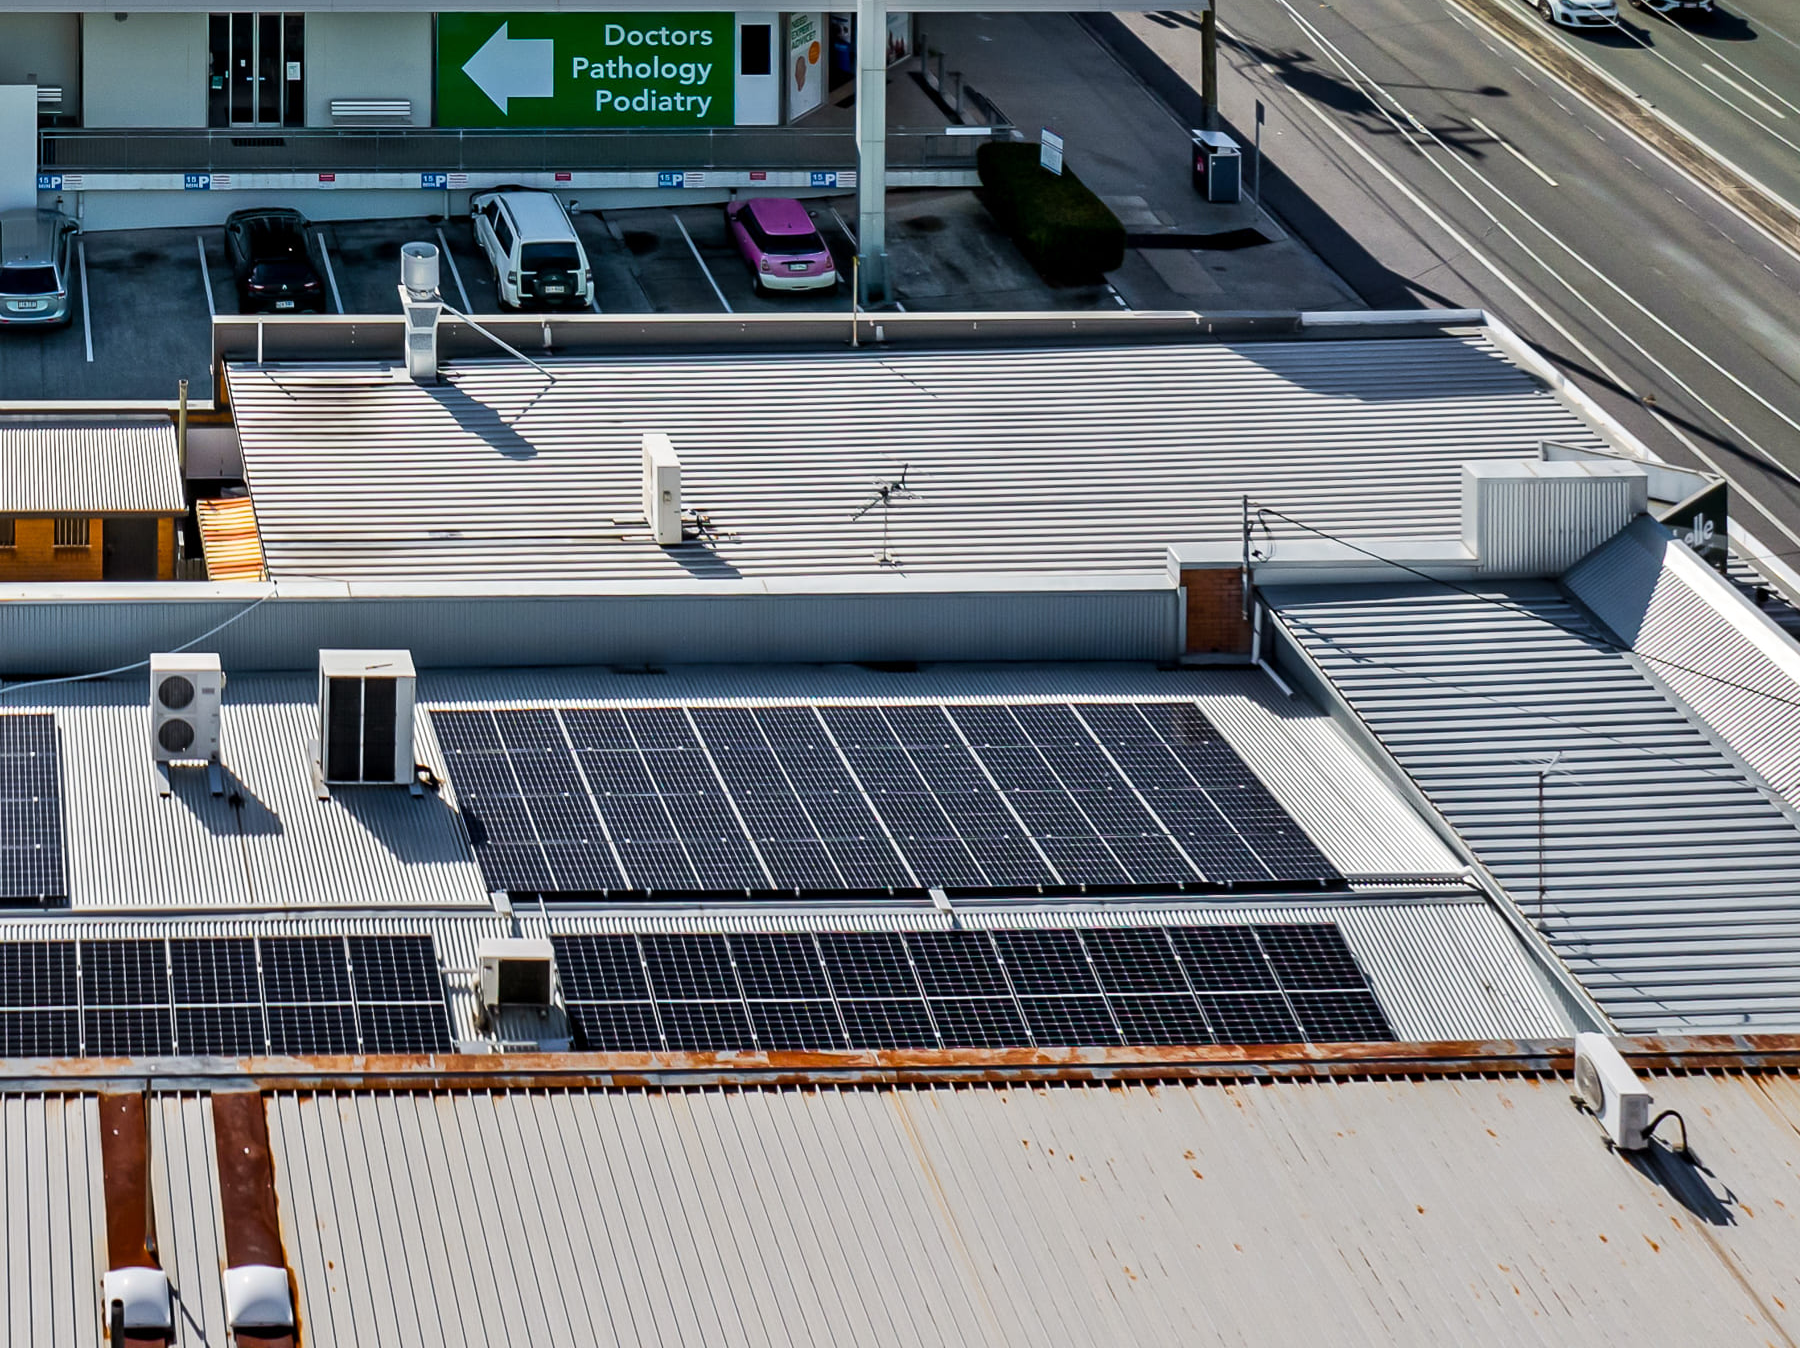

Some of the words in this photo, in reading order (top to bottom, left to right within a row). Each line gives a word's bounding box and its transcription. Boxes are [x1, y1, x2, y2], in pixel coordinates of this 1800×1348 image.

[604, 24, 713, 46] Doctors
[572, 56, 712, 86] Pathology
[595, 90, 712, 118] Podiatry
[51, 176, 62, 188] P
[199, 176, 209, 188] P
[436, 175, 446, 187] P
[672, 174, 683, 186] P
[825, 174, 836, 185] P
